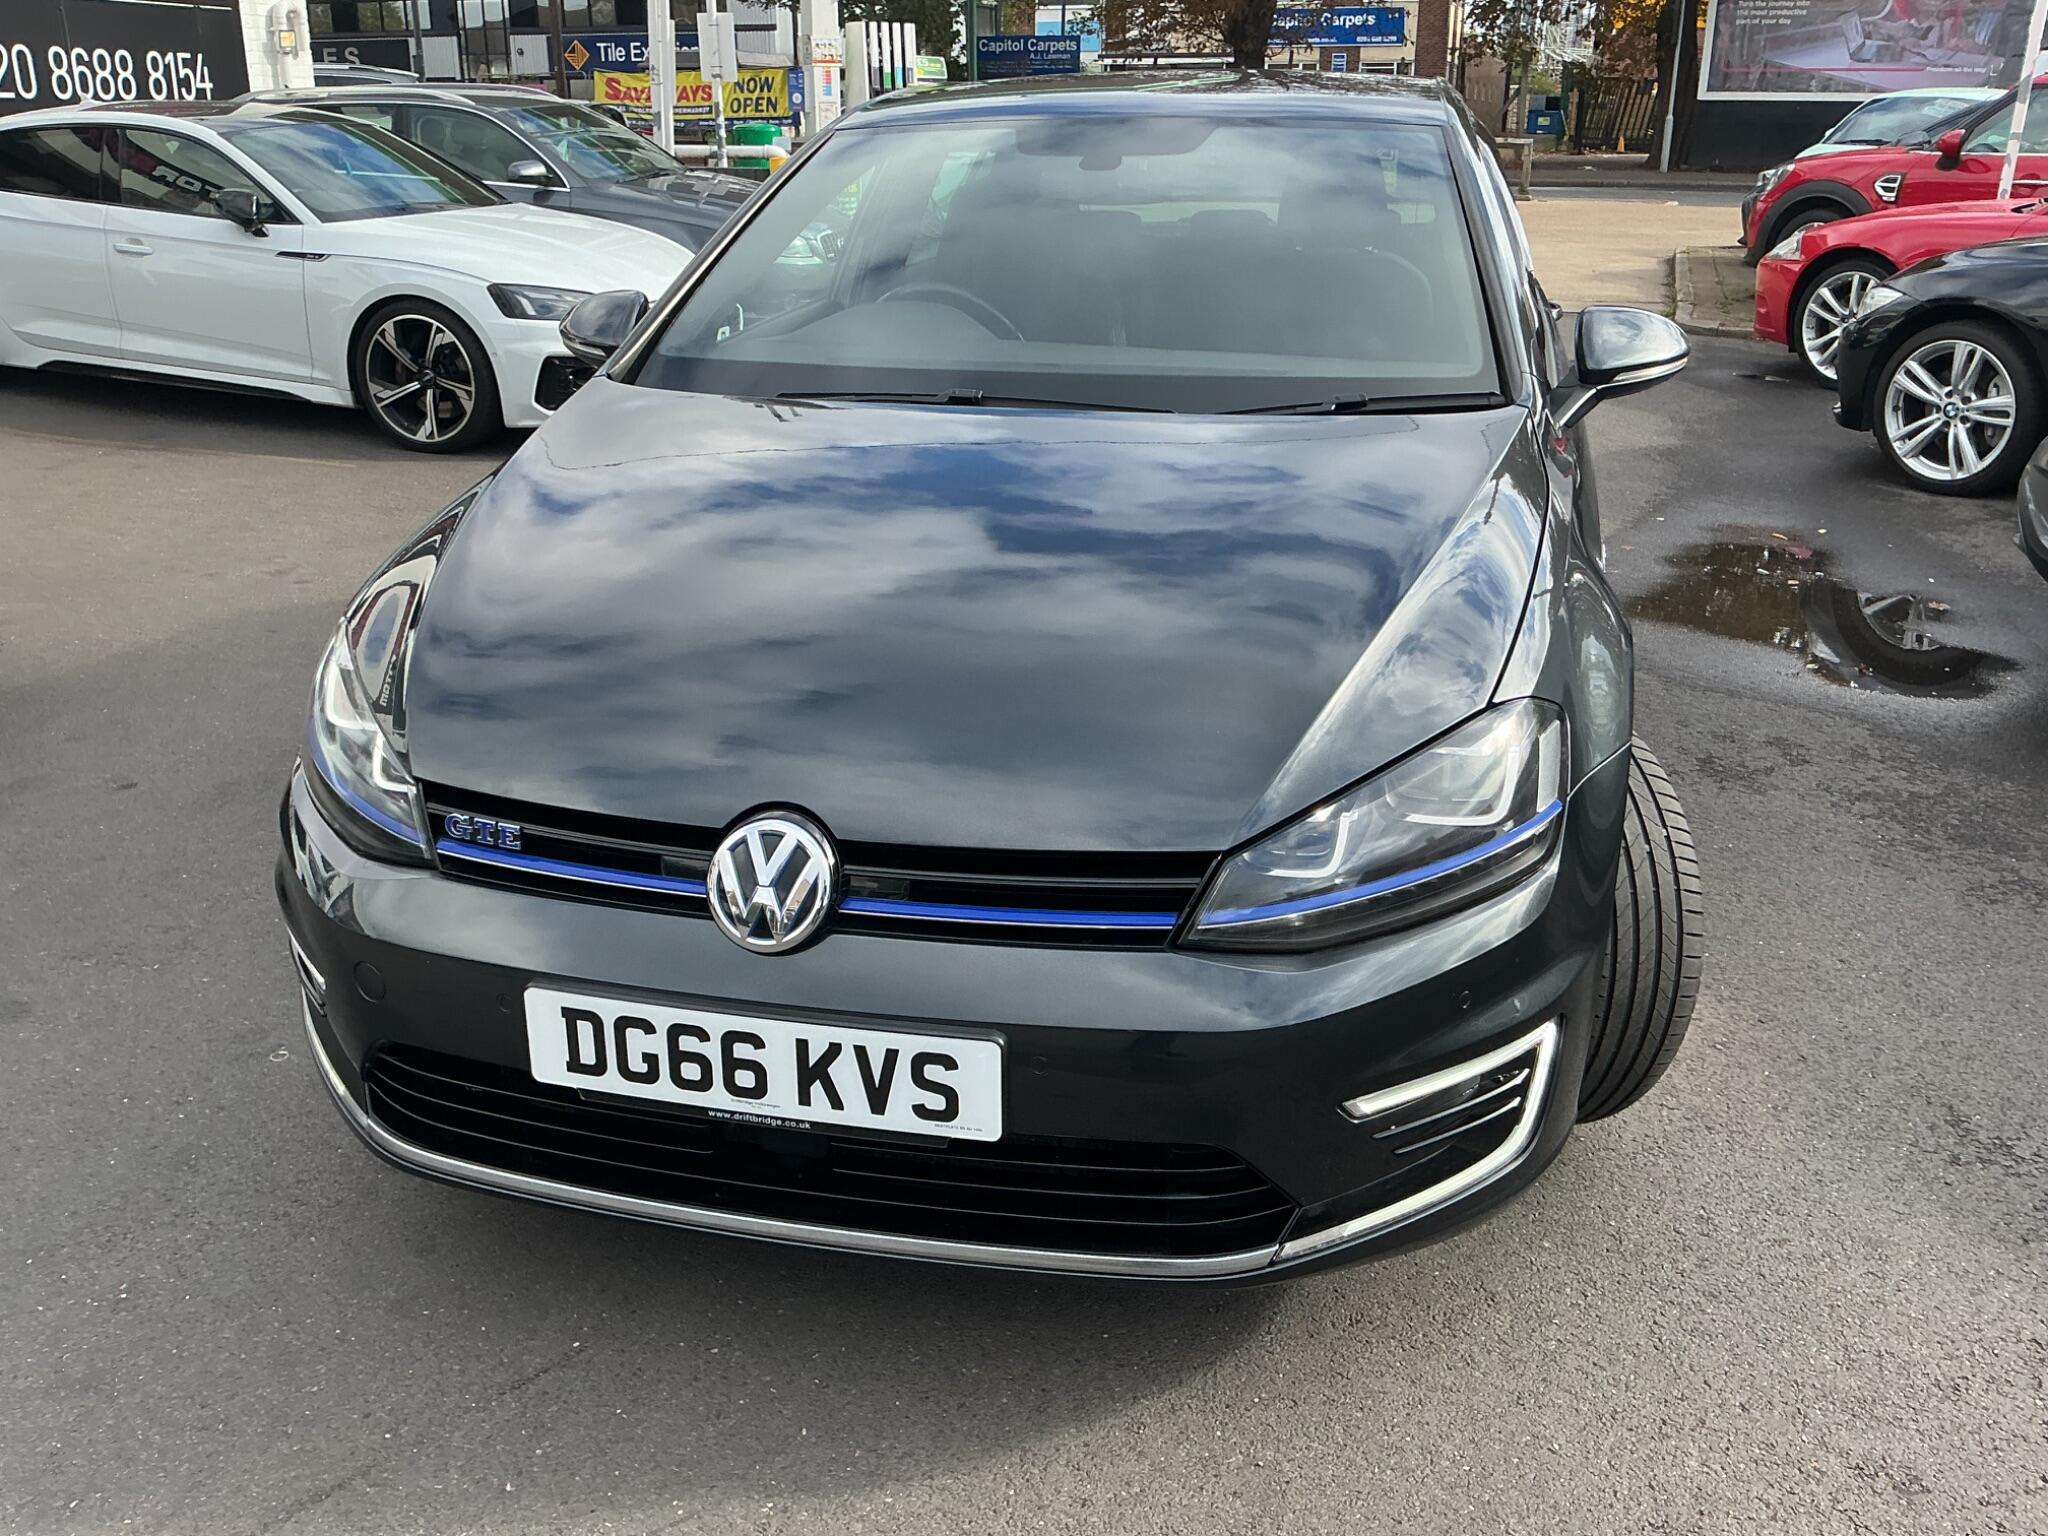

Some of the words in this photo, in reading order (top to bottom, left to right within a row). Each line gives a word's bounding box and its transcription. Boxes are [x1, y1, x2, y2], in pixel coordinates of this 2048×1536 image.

[1321, 12, 1377, 29] Carpets
[596, 42, 626, 62] Tile
[979, 38, 1024, 54] Capitol
[1027, 38, 1078, 54] Carpets
[48, 45, 138, 101] 8688
[146, 50, 214, 101] 8154
[734, 76, 775, 94] NOW
[730, 97, 778, 114] OPEN
[444, 813, 521, 850] GTE
[560, 1006, 769, 1100] DG66
[795, 1037, 960, 1123] KVS
[707, 1109, 812, 1130] www.driftbridge.co.uk
